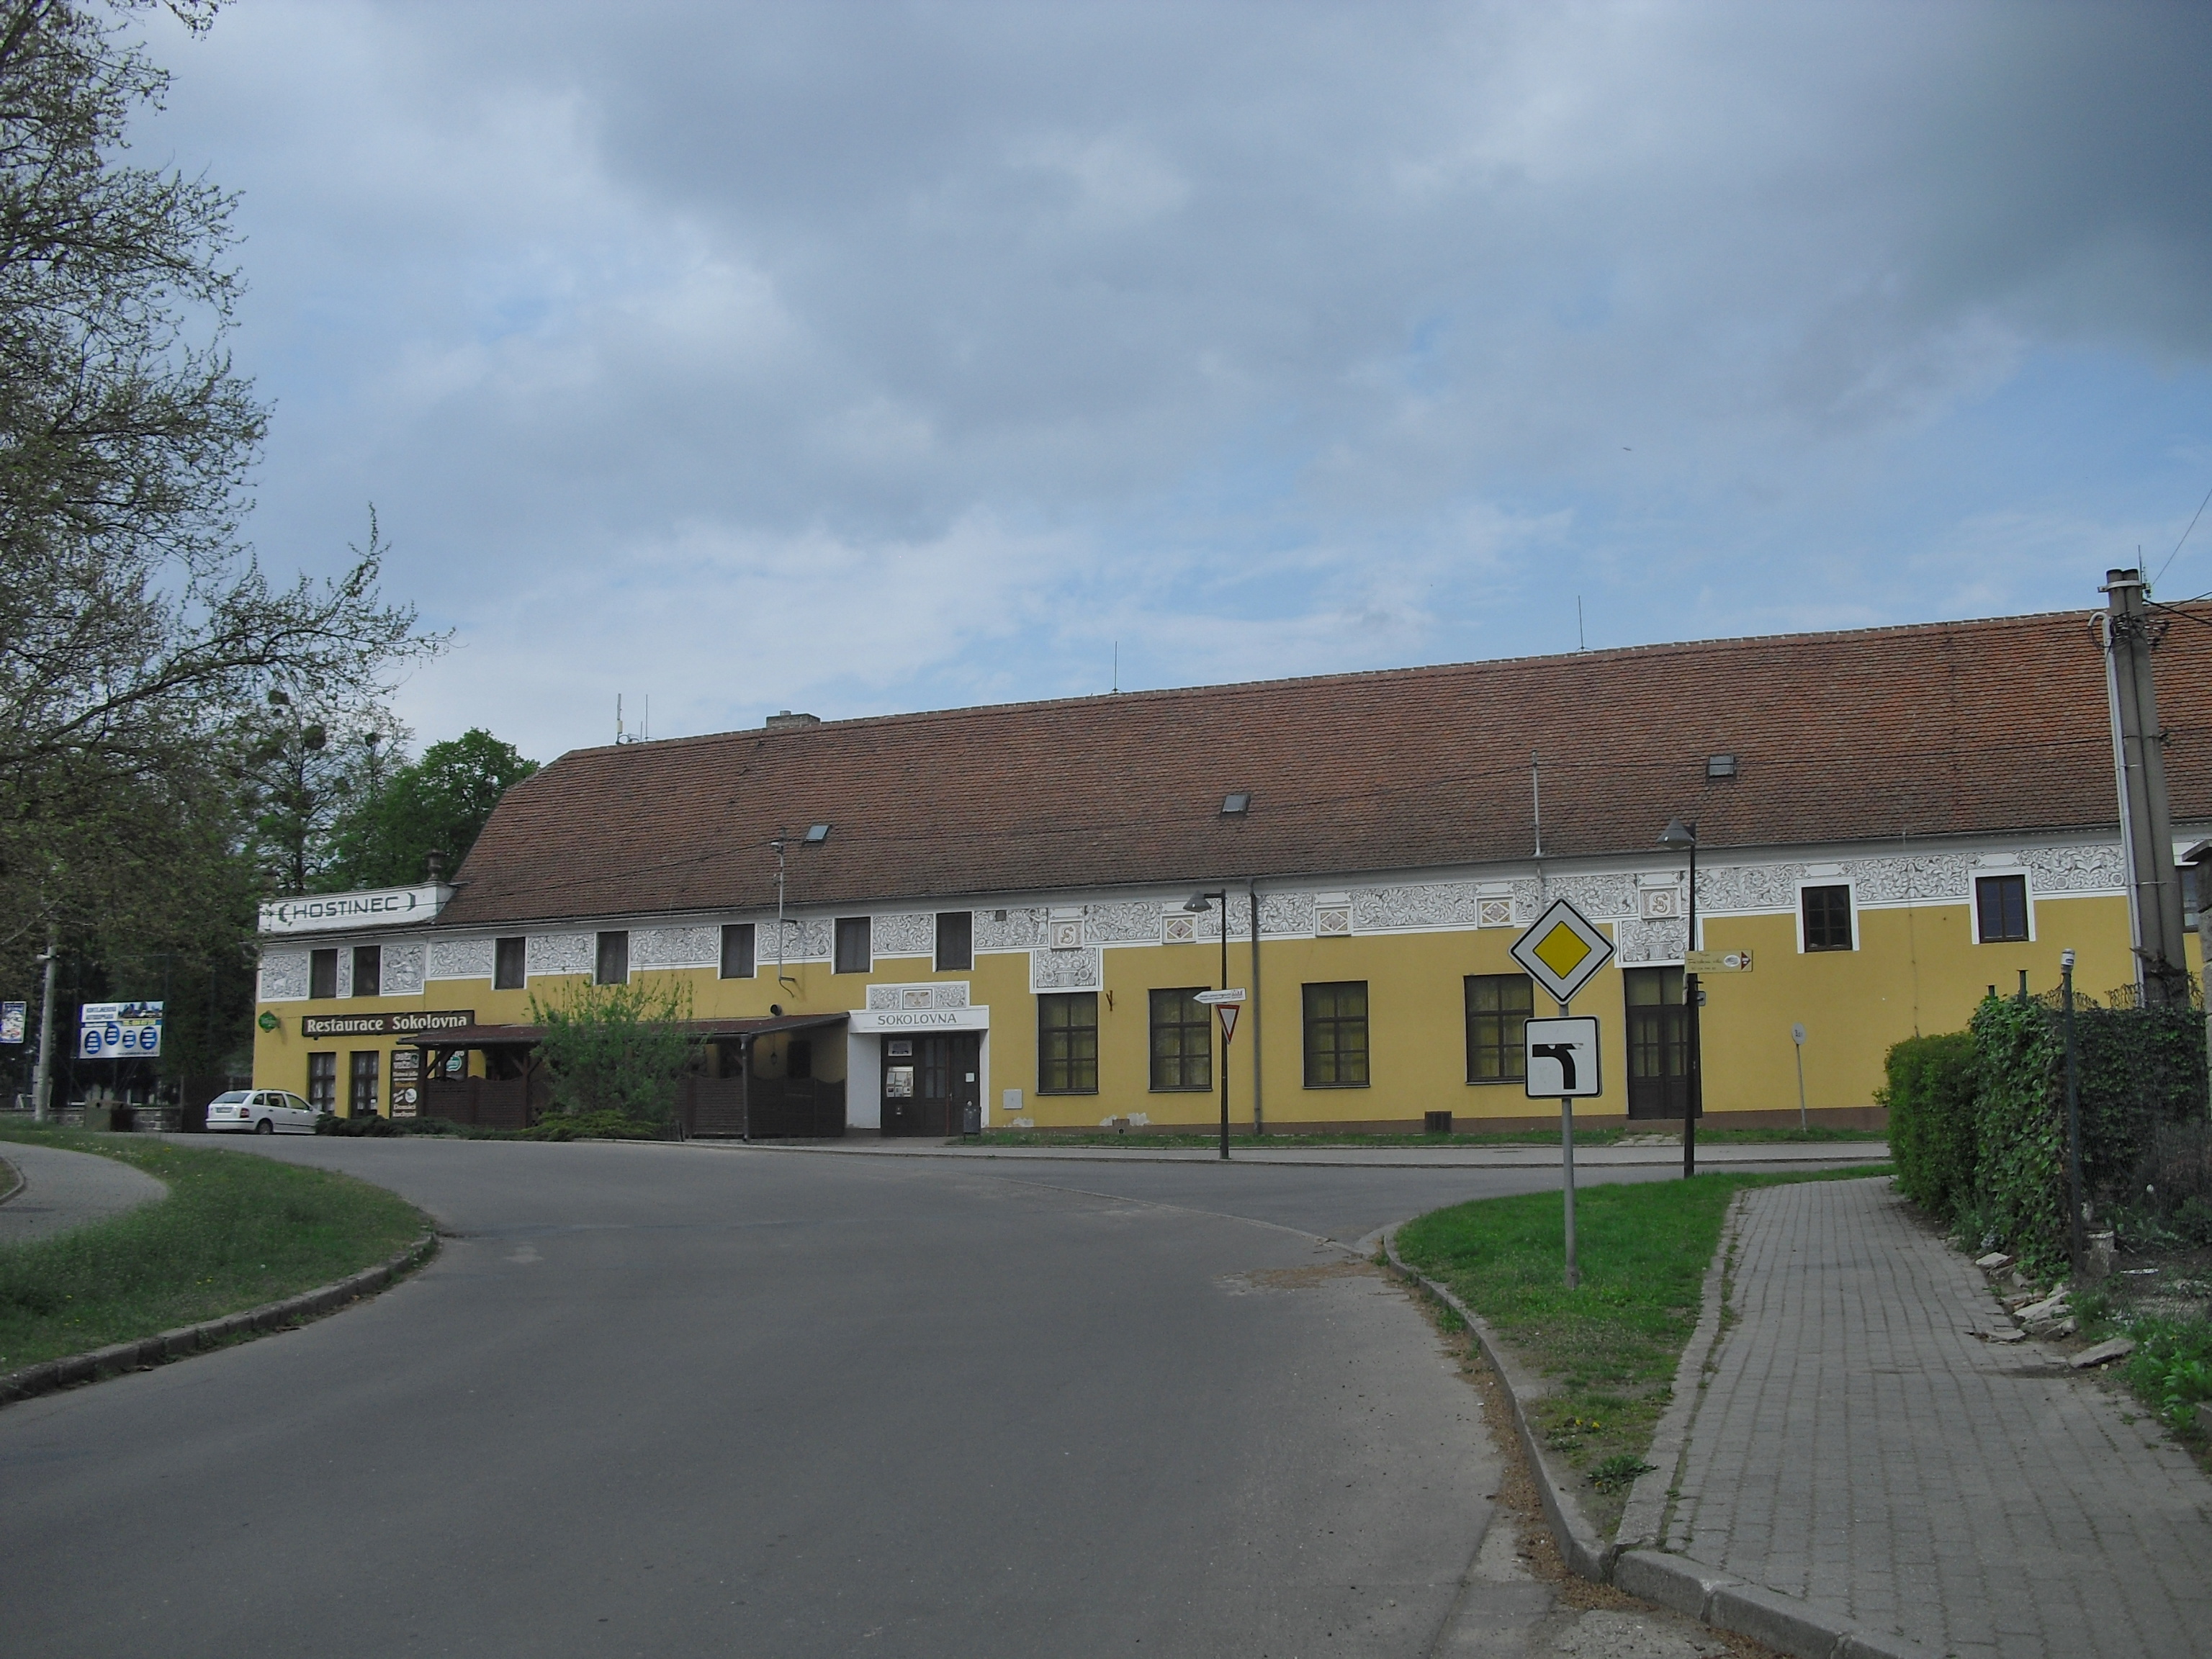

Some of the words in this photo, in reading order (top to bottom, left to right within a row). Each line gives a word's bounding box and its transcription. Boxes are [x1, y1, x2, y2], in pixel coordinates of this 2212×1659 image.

[293, 896, 399, 919] HOSTINEC
[307, 1019, 384, 1033] Restaurace
[392, 1014, 467, 1030] Sokolovna
[878, 1013, 957, 1025] SOKOLOVNA
